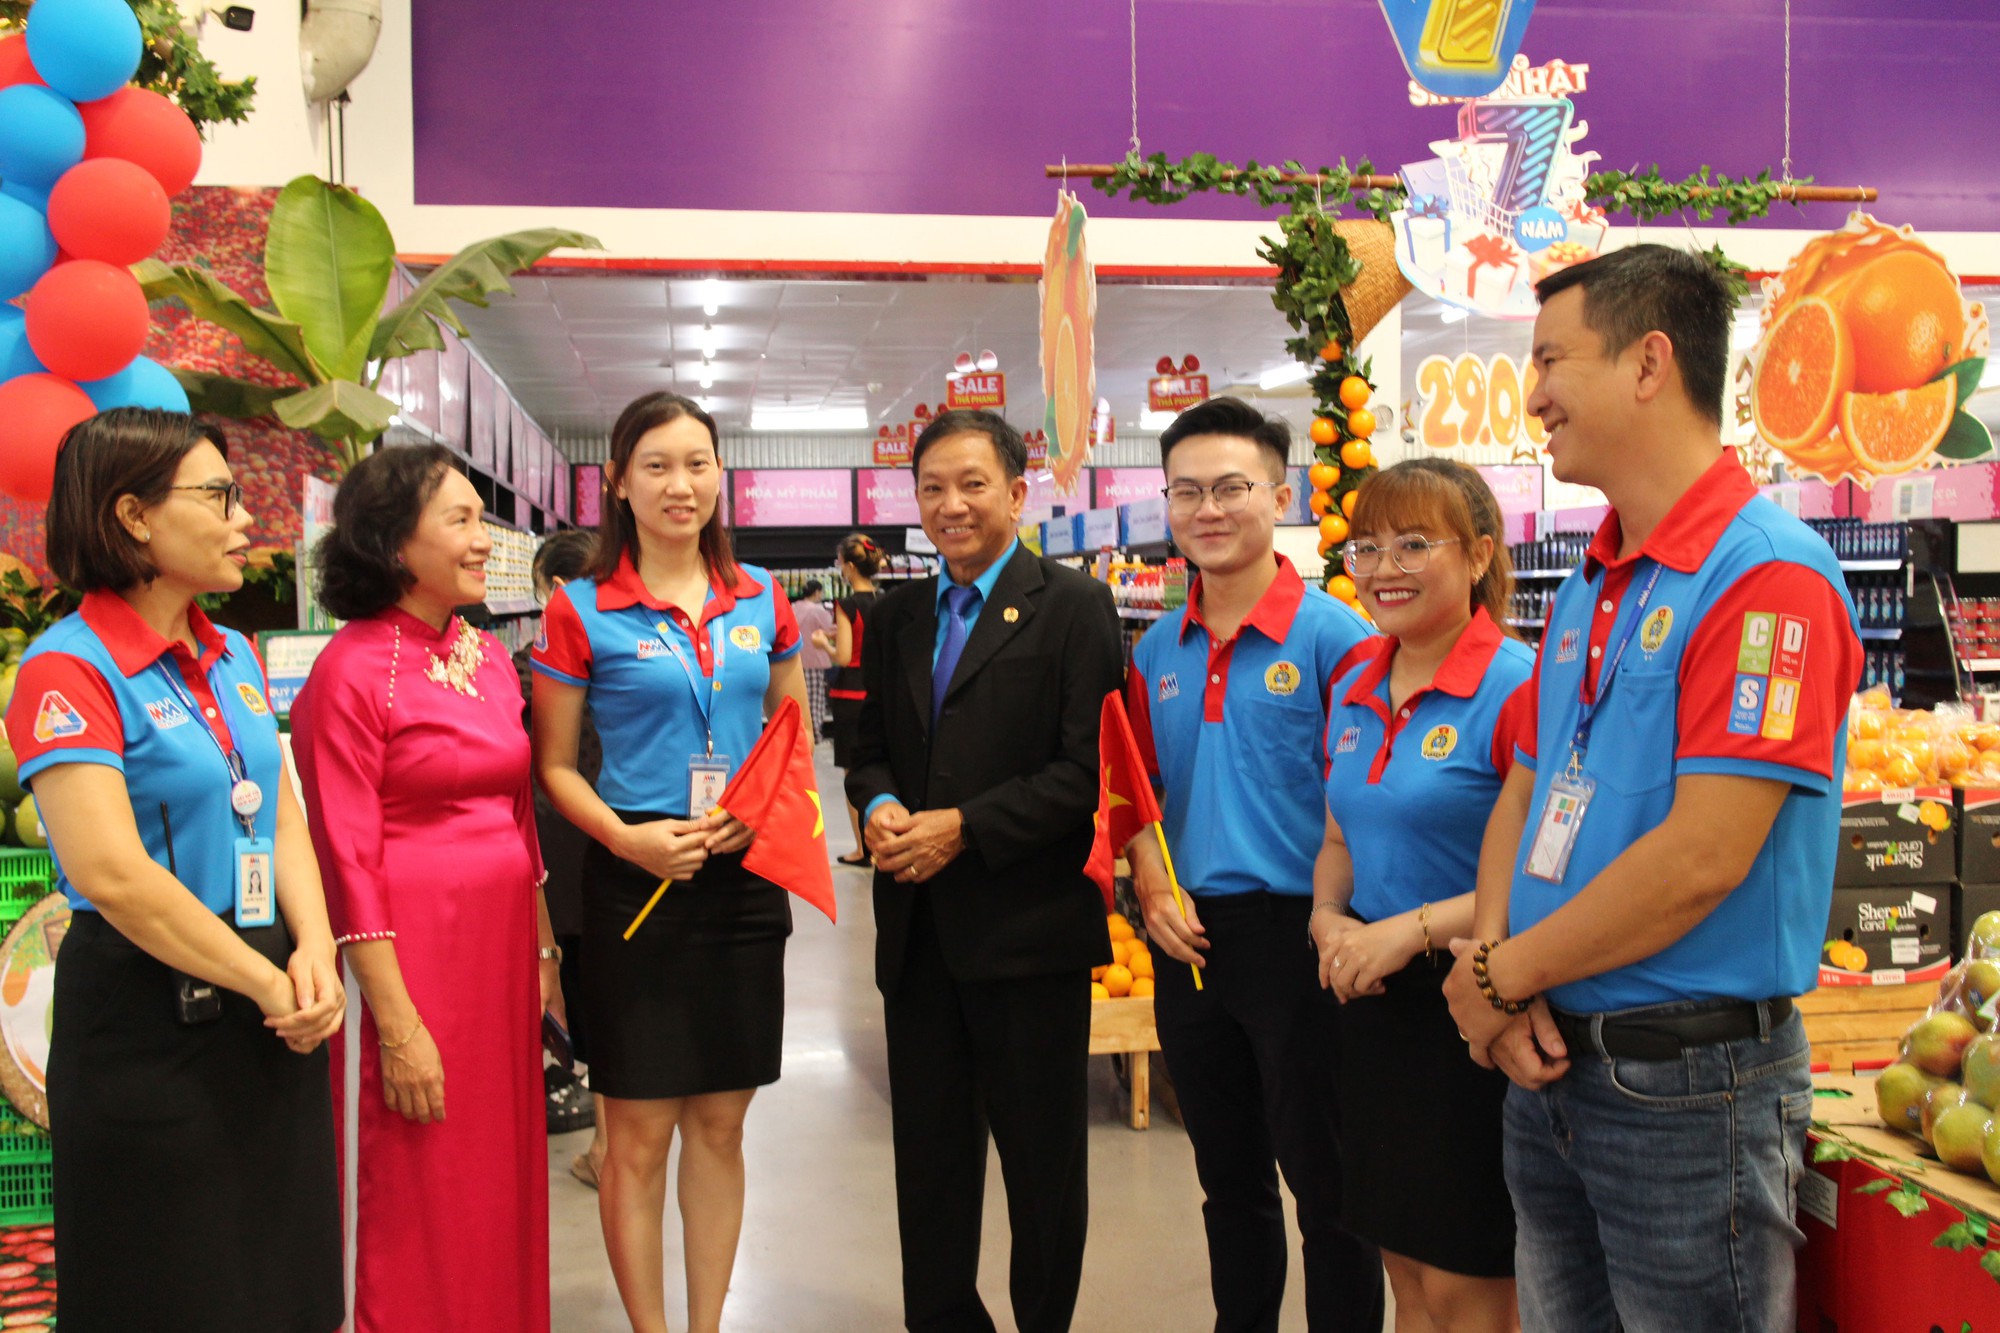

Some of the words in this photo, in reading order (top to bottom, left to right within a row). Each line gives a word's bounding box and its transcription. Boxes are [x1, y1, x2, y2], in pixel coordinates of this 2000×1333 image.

[1520, 217, 1564, 240] NĂM
[954, 377, 998, 395] SALE
[877, 441, 909, 455] SALE
[1747, 616, 1770, 648] C
[1782, 619, 1804, 653] D
[1738, 678, 1760, 710] S
[1773, 682, 1796, 716] H
